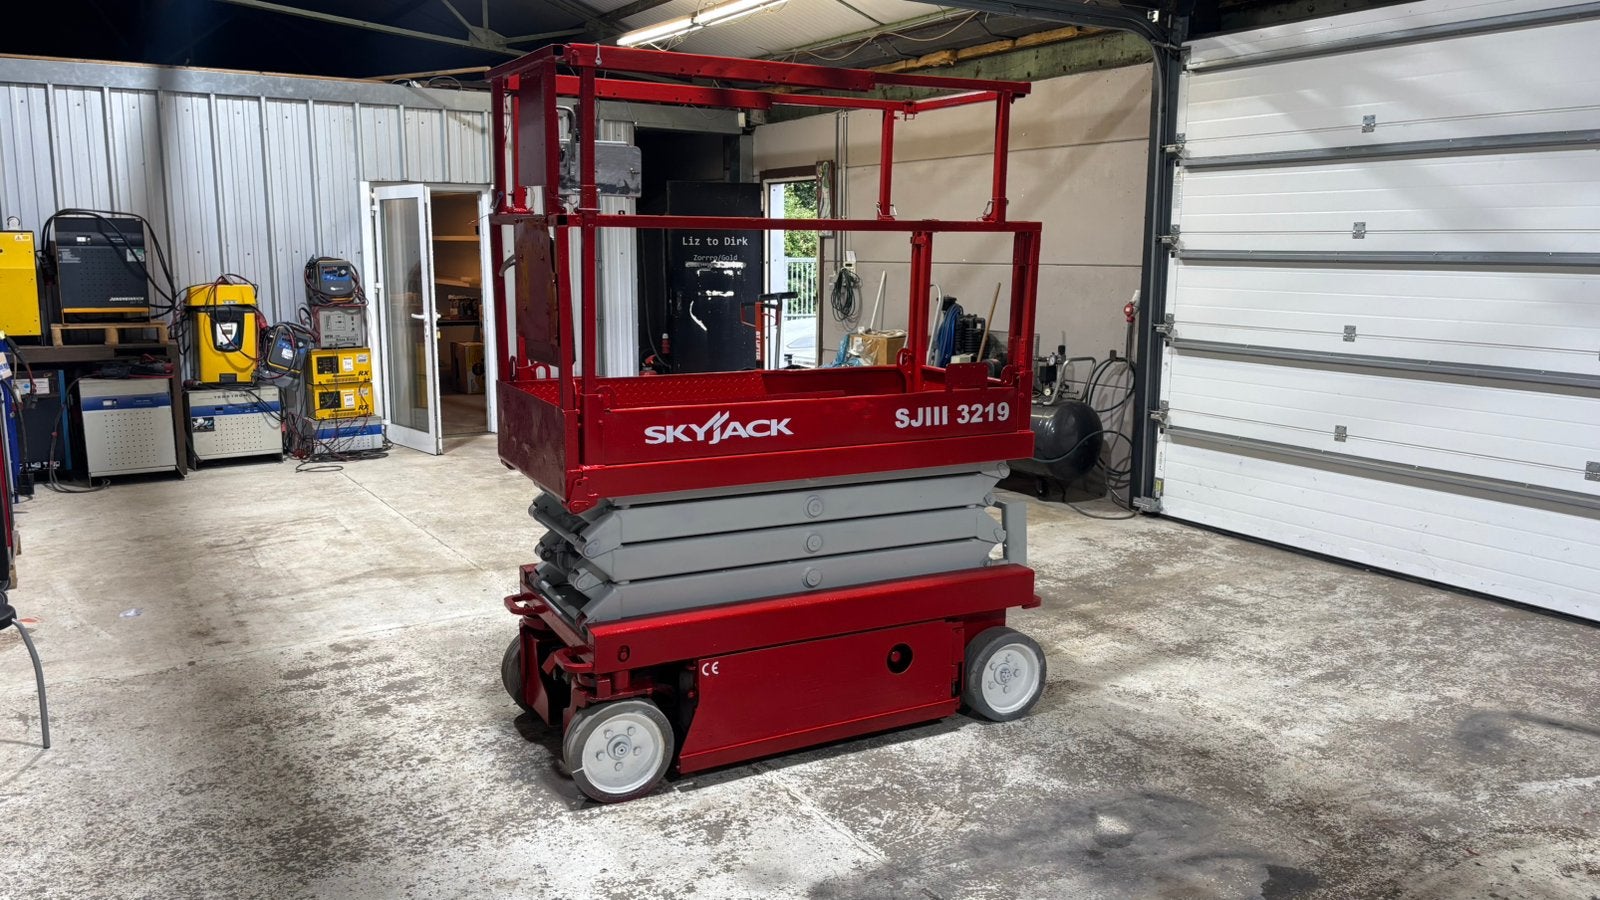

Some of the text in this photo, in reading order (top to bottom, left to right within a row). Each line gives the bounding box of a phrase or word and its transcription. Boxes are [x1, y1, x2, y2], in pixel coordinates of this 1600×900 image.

[682, 236, 748, 246] Liz to Dirk
[895, 402, 1010, 429] SJIII 3219
[644, 410, 794, 445] SKYJACK
[702, 661, 719, 676] CE
